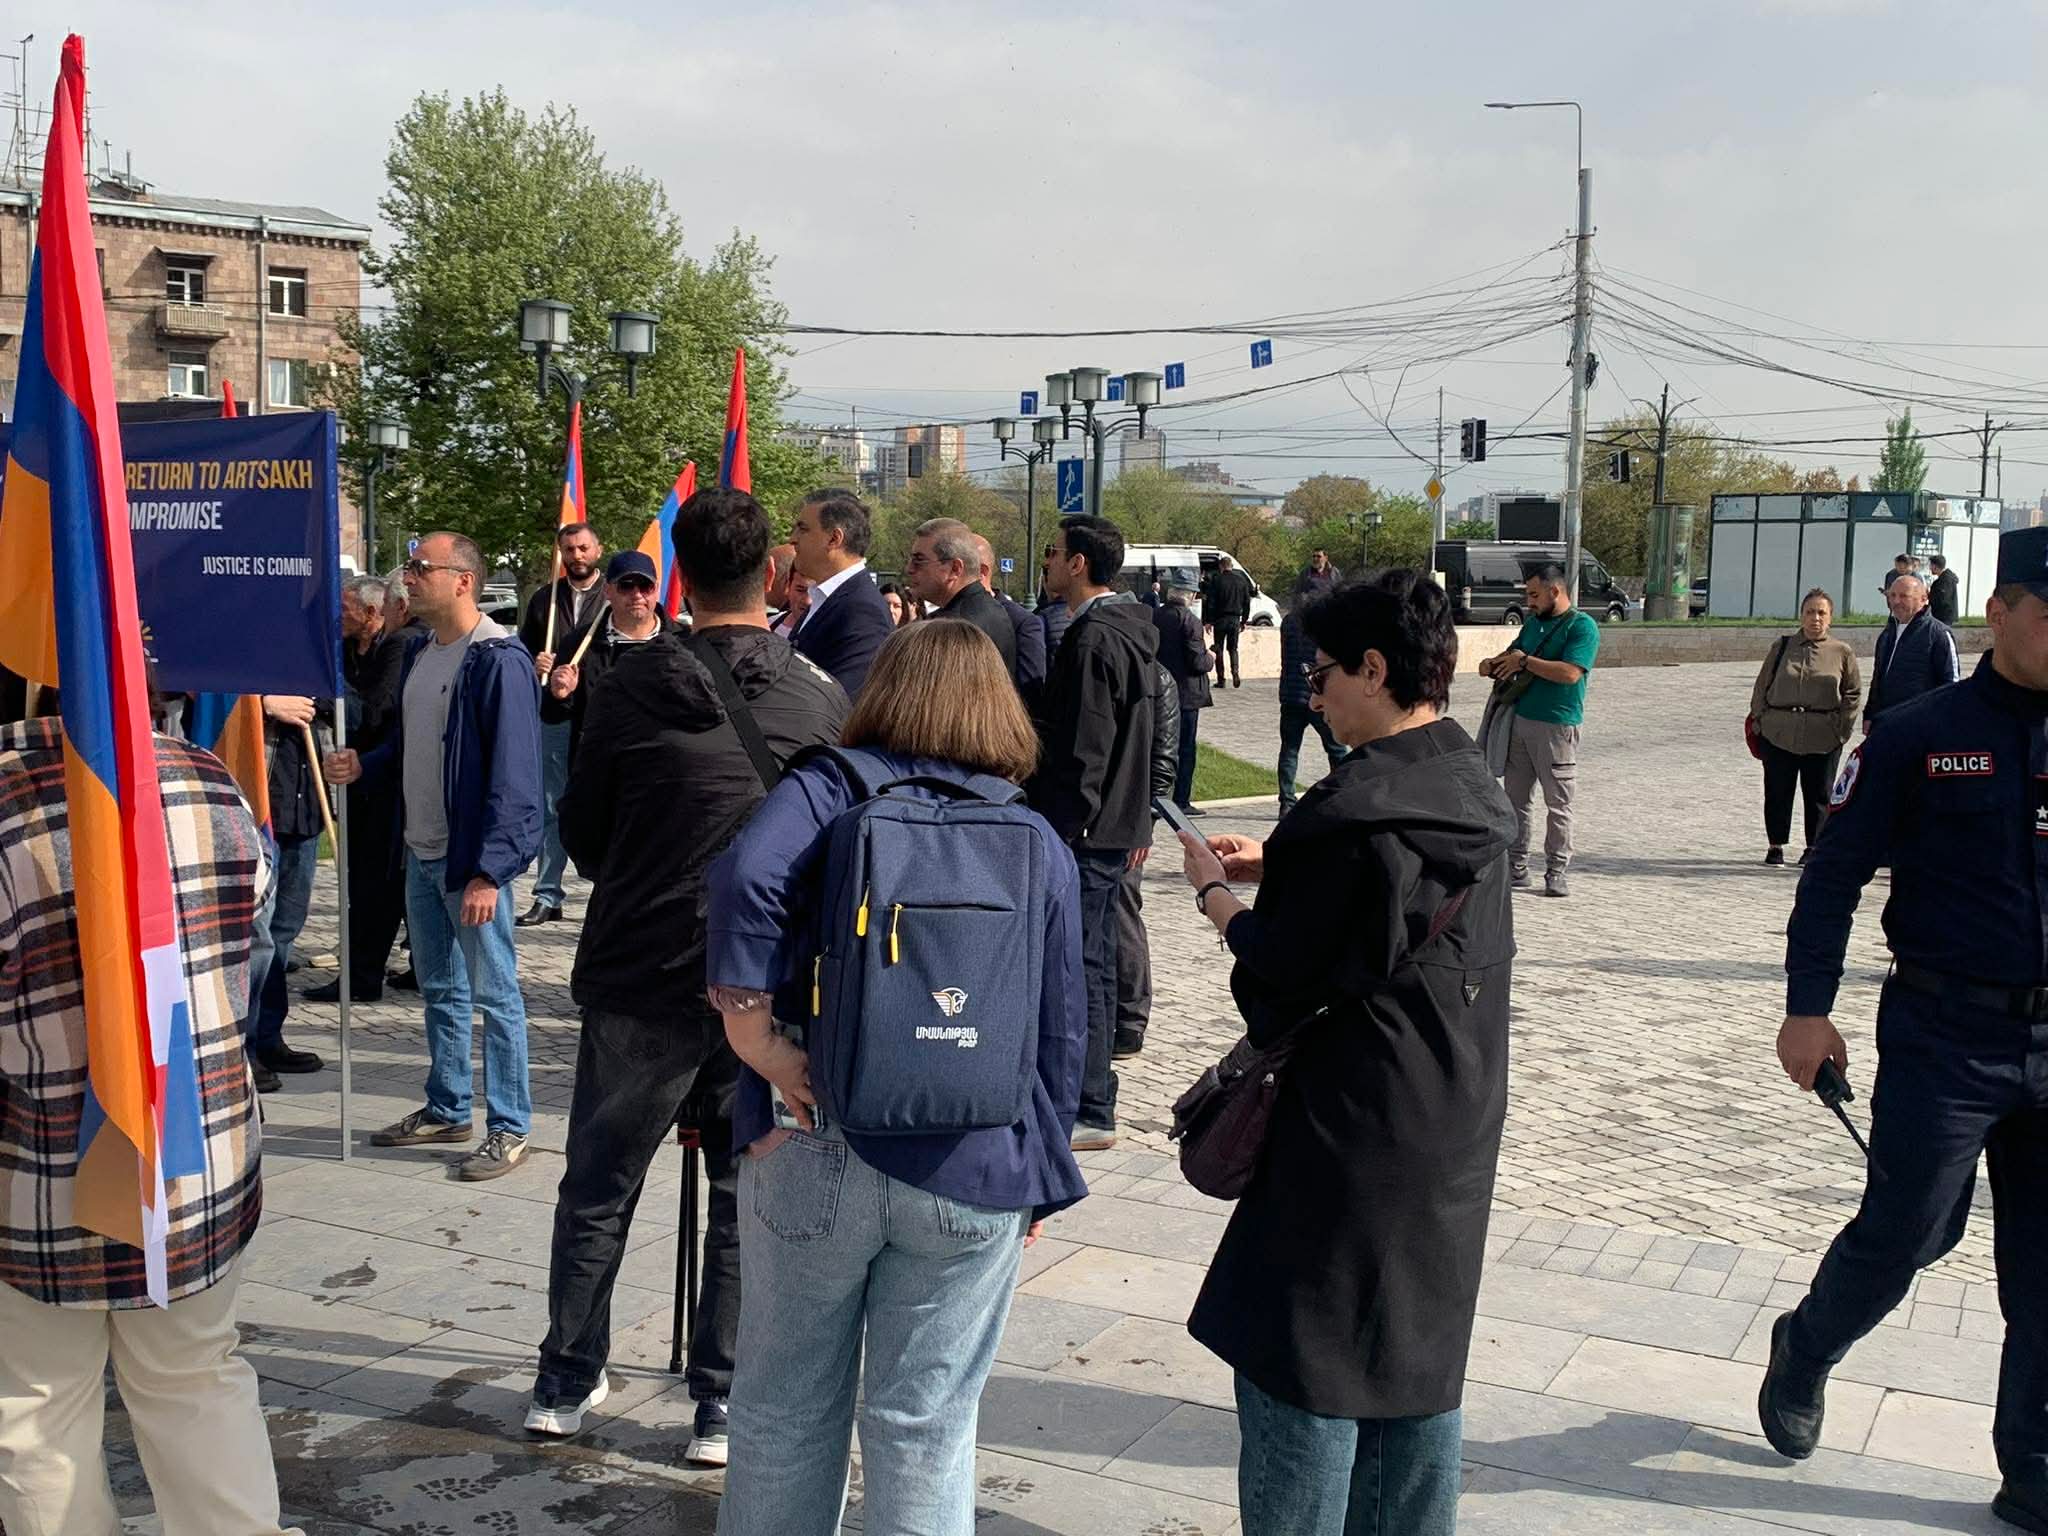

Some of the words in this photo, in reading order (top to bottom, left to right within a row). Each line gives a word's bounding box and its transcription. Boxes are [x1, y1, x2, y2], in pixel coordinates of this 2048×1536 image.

[126, 462, 194, 490] RETURN
[200, 461, 221, 489] TO
[222, 459, 313, 488] ARTSAKH
[128, 501, 223, 530] MPROMISE
[202, 556, 251, 575] JUSTICE
[254, 557, 265, 575] IS
[267, 557, 313, 576] COMING
[1931, 756, 1990, 773] POLICE
